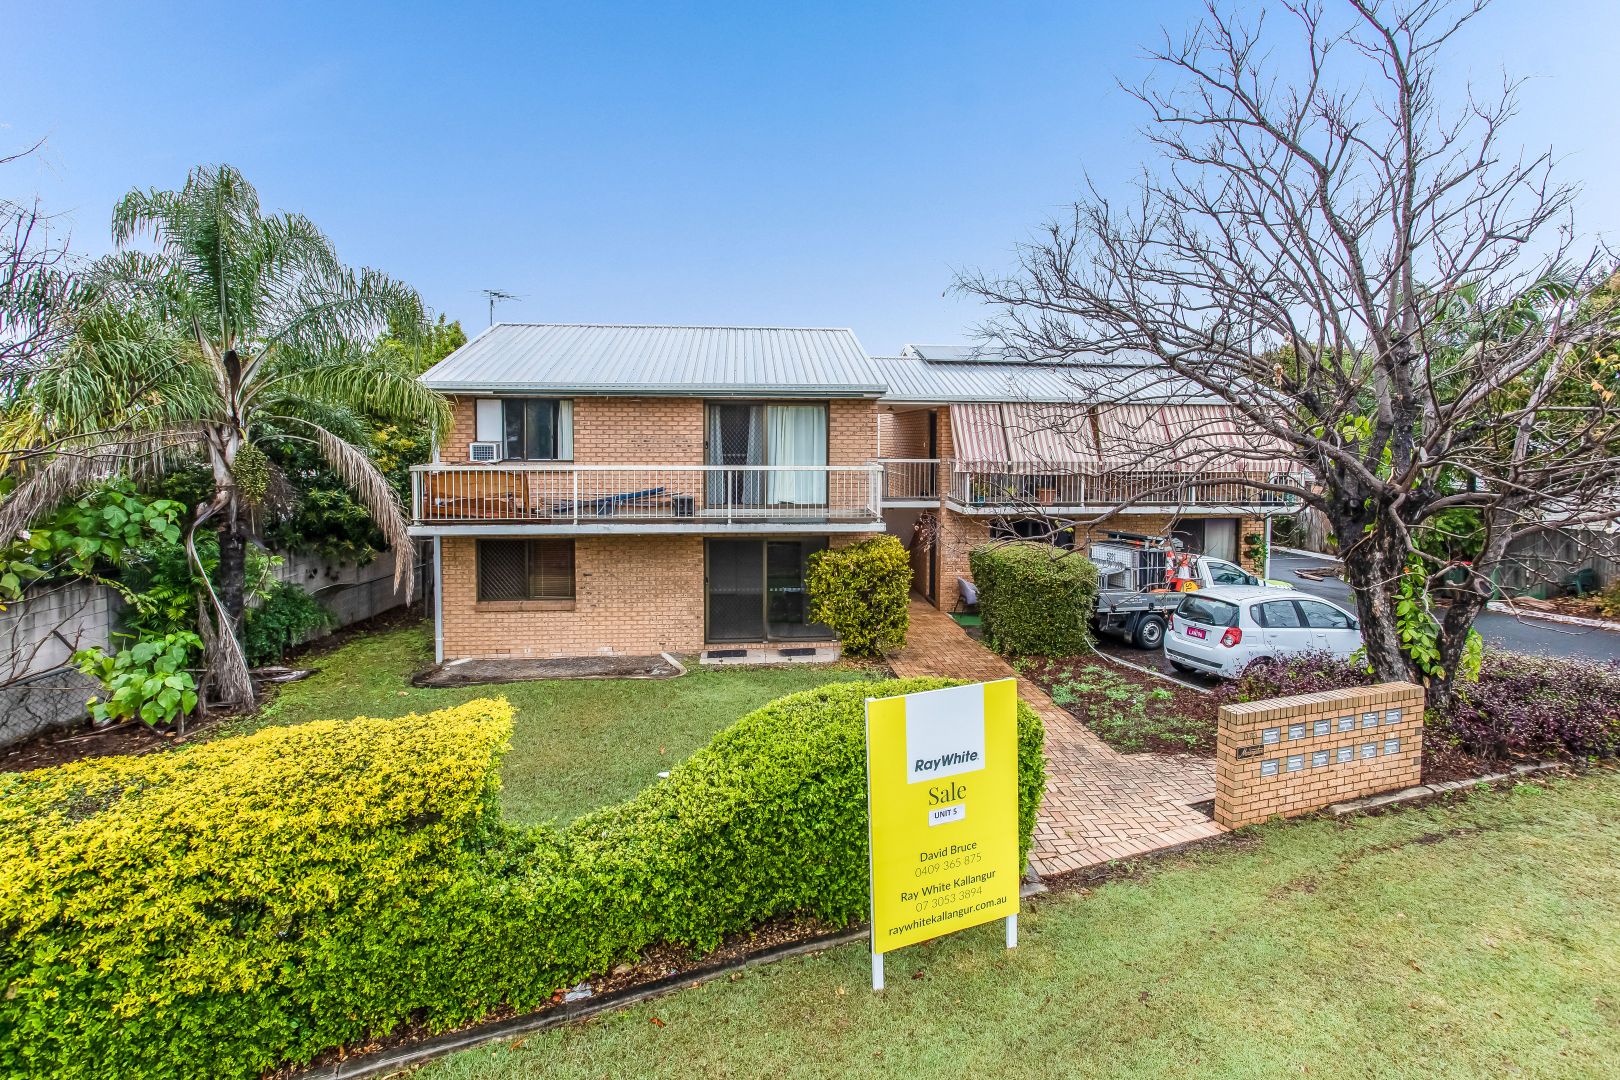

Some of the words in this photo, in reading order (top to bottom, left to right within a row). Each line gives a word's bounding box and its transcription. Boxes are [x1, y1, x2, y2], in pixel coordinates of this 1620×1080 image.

[928, 781, 967, 806] Sale
[934, 809, 952, 819] UNIT
[952, 807, 958, 816] 5
[920, 846, 948, 862] David
[950, 841, 978, 855] Bruce
[914, 863, 940, 878] 0409
[943, 857, 961, 871] 365
[964, 852, 982, 866] 875
[900, 892, 919, 903] Ray
[921, 882, 951, 897] White
[953, 869, 996, 889] Kallangur
[915, 901, 929, 913] 07
[931, 894, 956, 909] 3053
[958, 886, 983, 901] 3894
[888, 896, 1007, 936] raywhitekallangur.com.au
